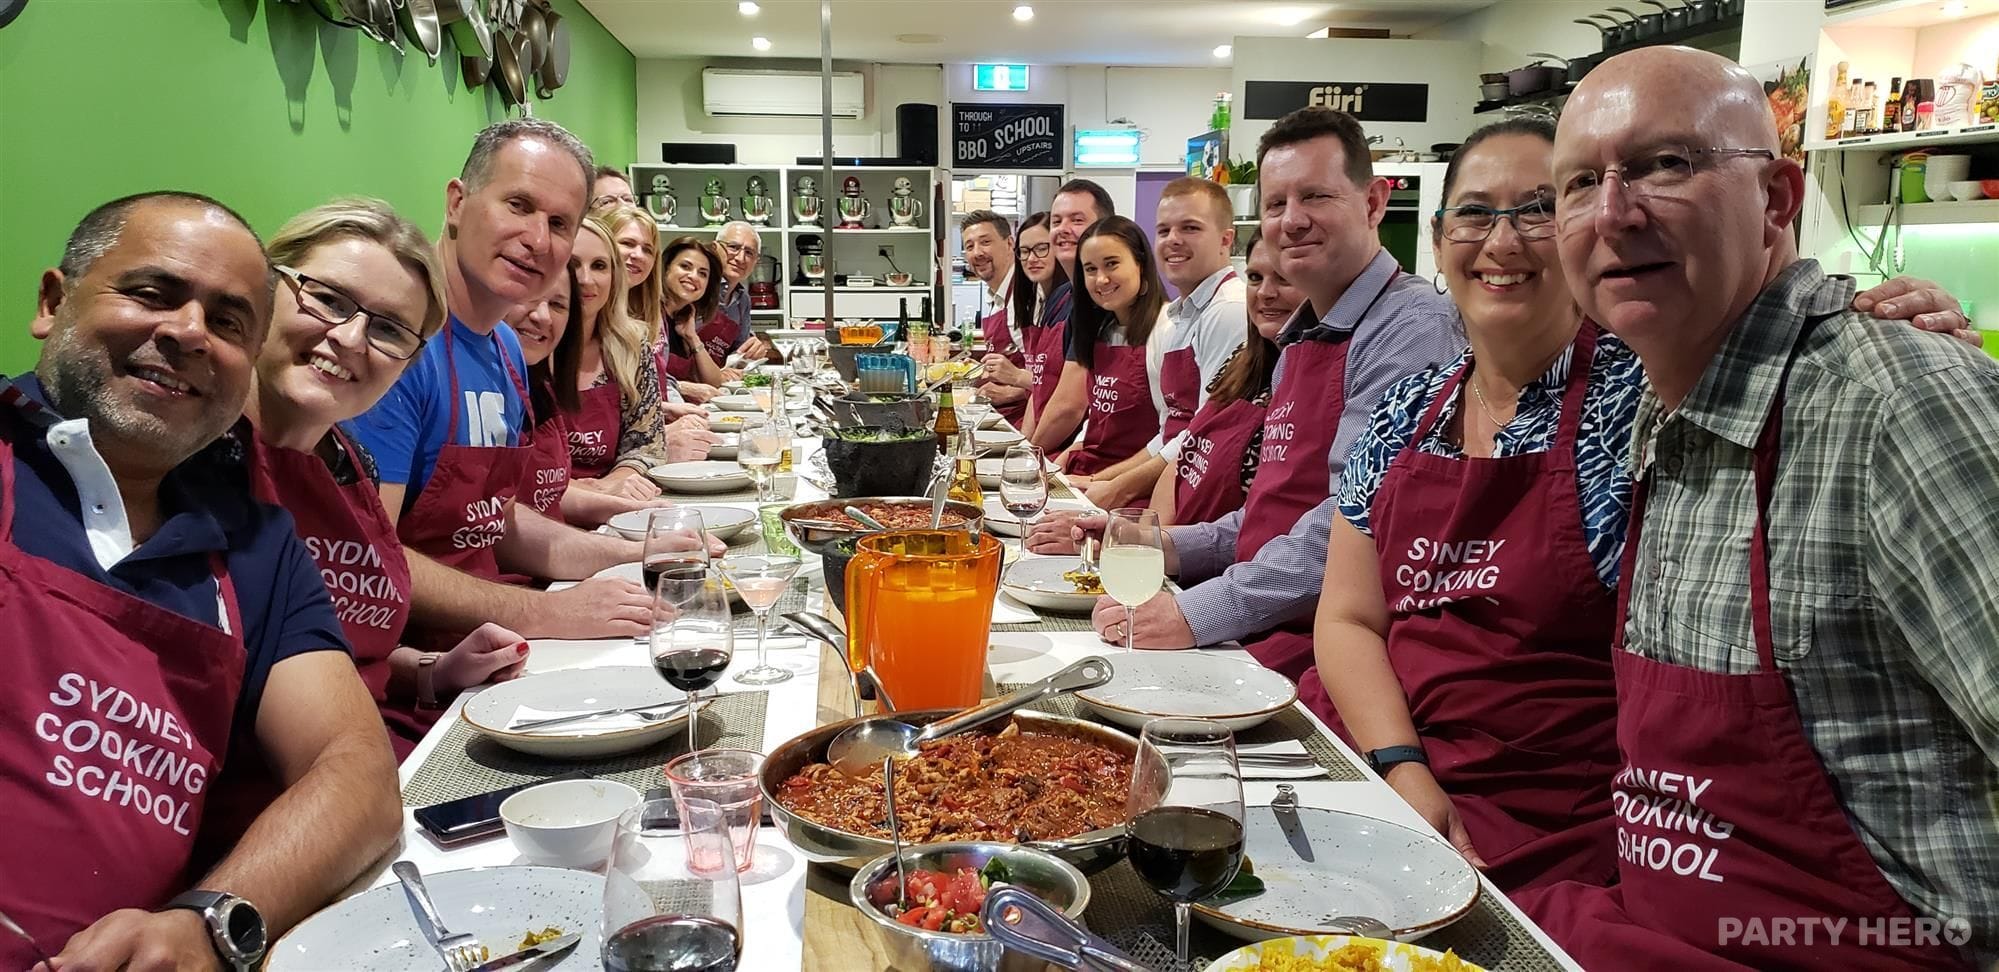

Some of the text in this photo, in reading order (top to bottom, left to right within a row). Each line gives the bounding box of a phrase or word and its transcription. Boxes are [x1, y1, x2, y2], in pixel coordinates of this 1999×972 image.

[959, 111, 993, 122] THROUGH
[959, 122, 970, 133] TO
[958, 116, 1055, 160] BBQ SCHOOL
[1016, 142, 1053, 156] UPSTAIRS
[305, 536, 385, 568] SYDN
[320, 568, 404, 604] OOKIN
[49, 672, 193, 750] SYDNEY
[35, 712, 207, 795] COOKING
[46, 755, 190, 836] SCHOOL
[1612, 790, 1735, 840] OOKING
